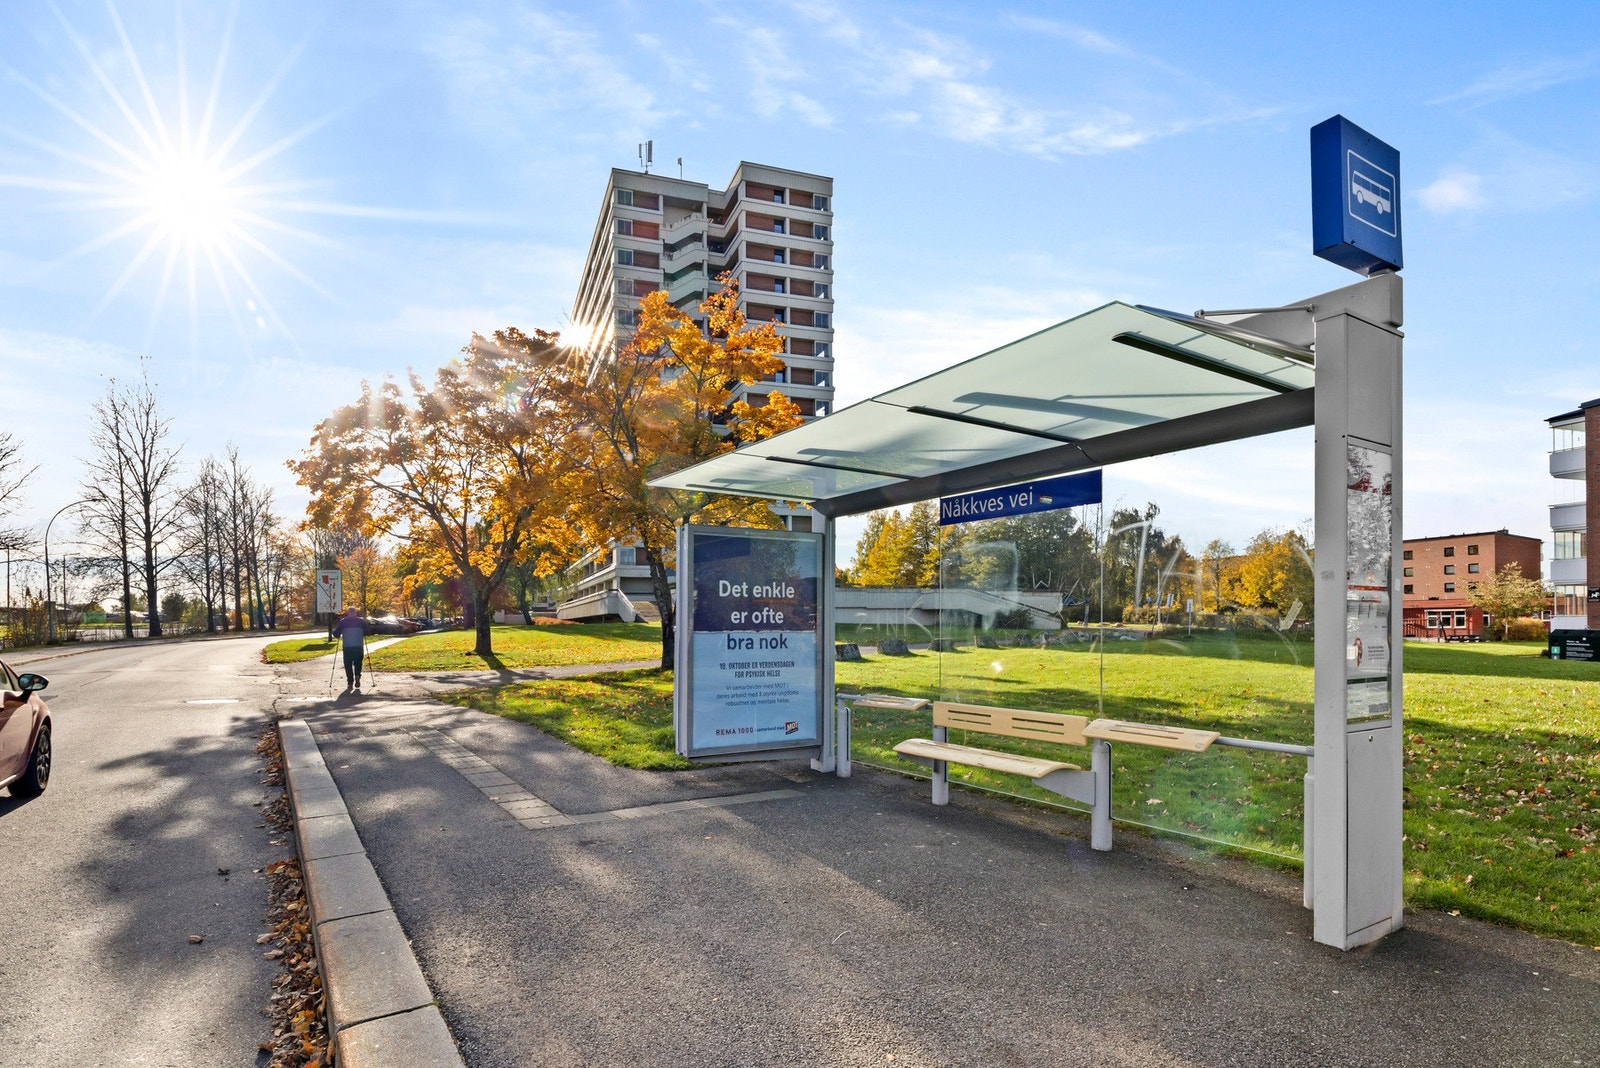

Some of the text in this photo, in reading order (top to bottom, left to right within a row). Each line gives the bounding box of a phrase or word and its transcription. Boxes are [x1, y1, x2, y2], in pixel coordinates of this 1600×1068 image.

[942, 486, 1033, 519] Nåkkves vei
[719, 580, 795, 599] Det enkle
[730, 606, 784, 624] er ofte
[727, 633, 788, 651] bra nok
[745, 670, 766, 678] PSYKISK
